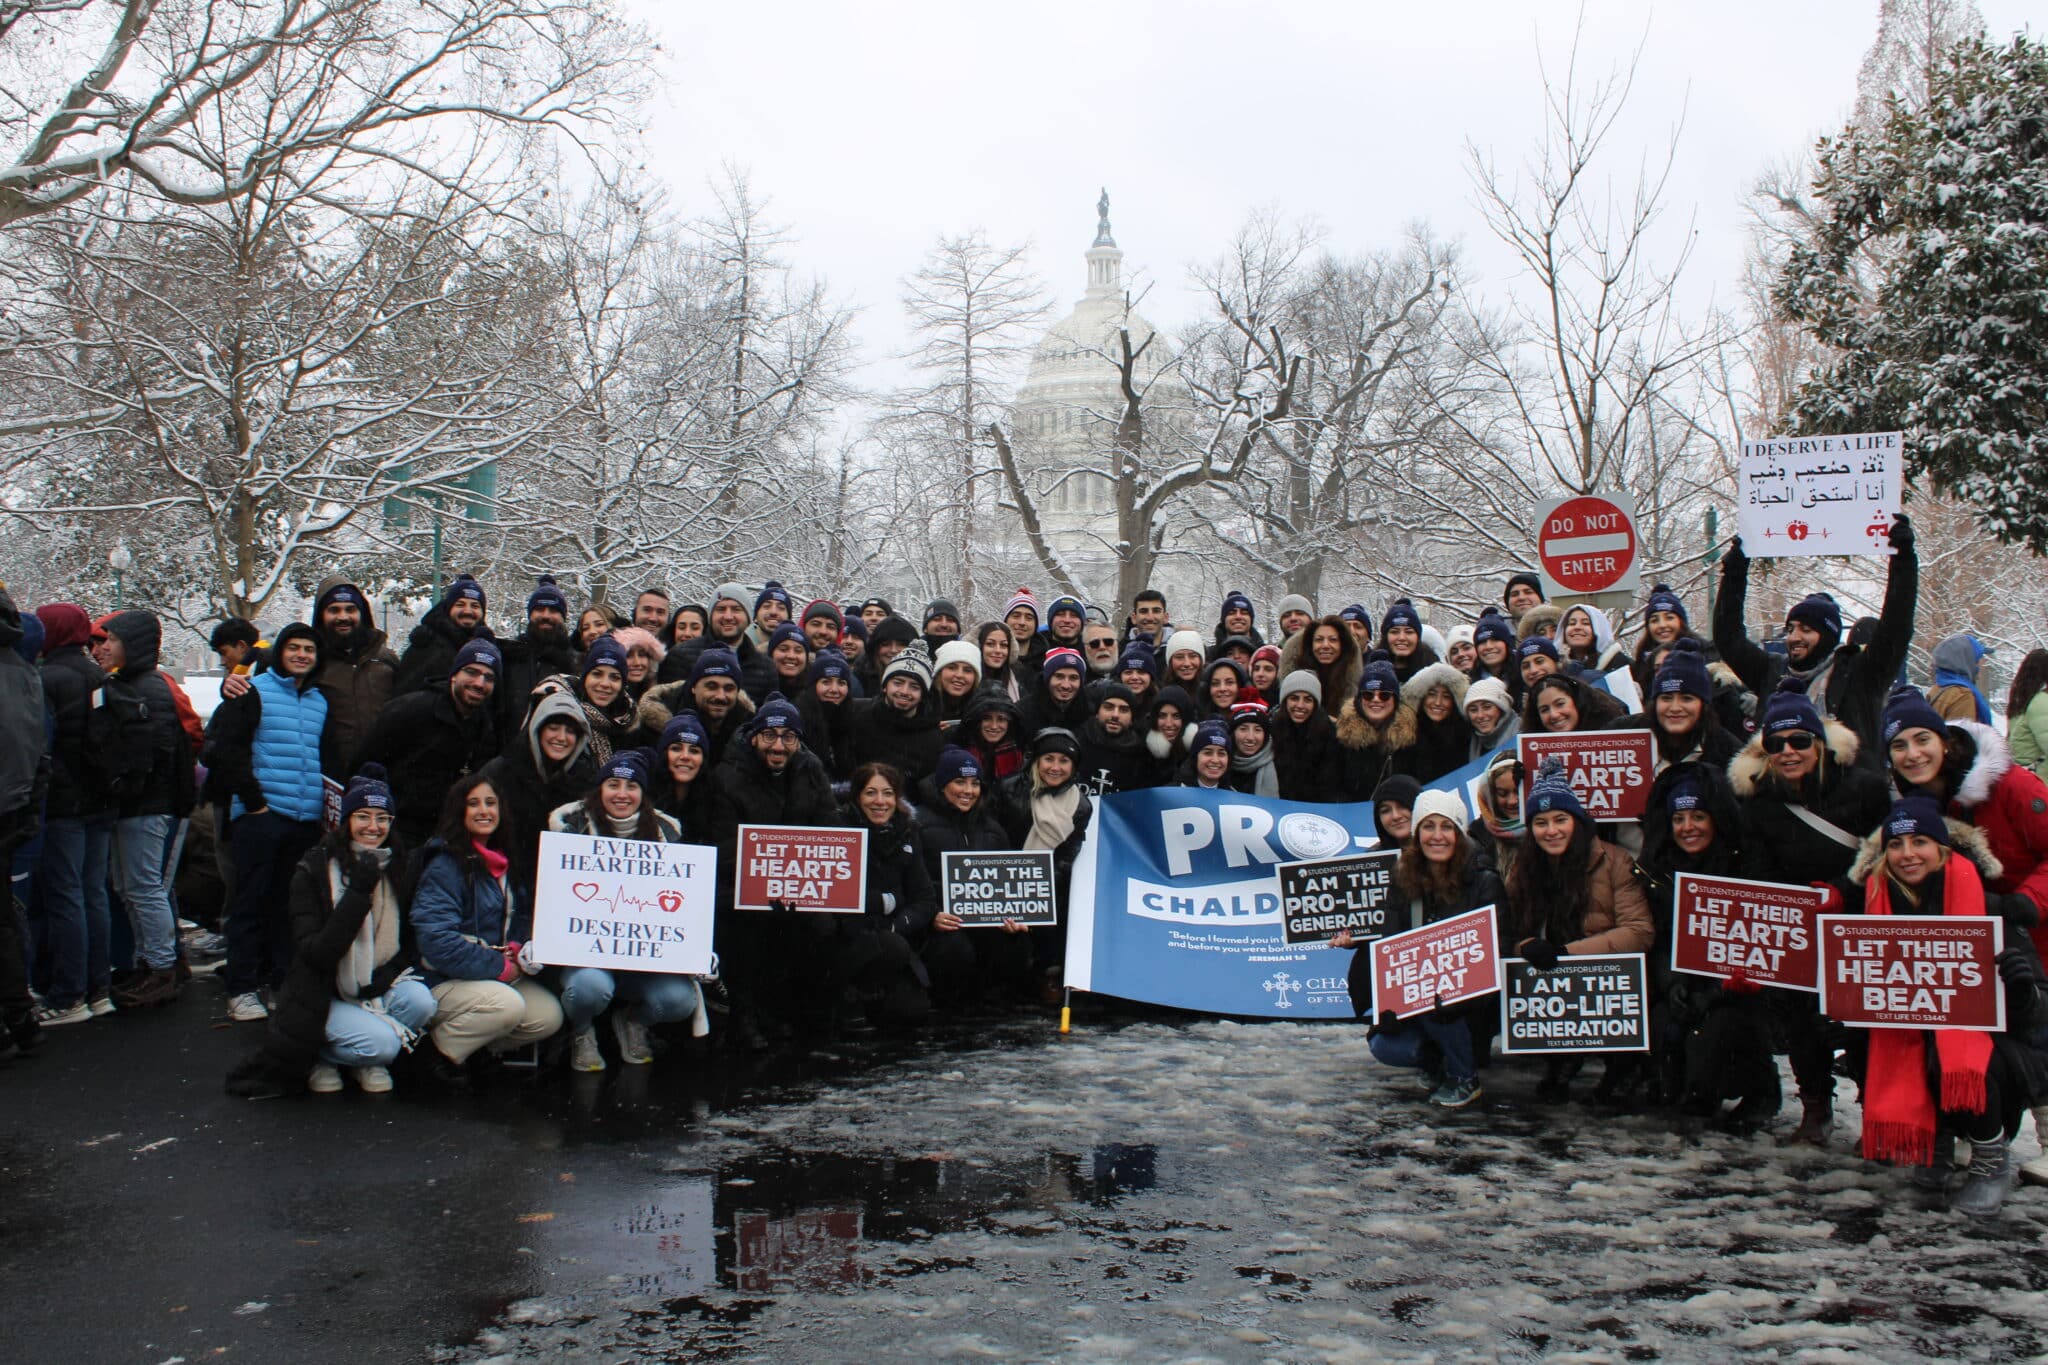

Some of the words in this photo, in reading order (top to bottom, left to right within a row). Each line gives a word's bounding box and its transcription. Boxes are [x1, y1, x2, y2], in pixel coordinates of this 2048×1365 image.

[1745, 445, 1750, 457] I
[1755, 439, 1833, 457] DESERVE
[1839, 440, 1850, 451] A
[1856, 435, 1896, 449] LIFE
[1750, 486, 1794, 509] الحياة
[1801, 480, 1858, 509] أستحق
[1866, 480, 1885, 501] أنا
[1551, 518, 1574, 534] DO
[1585, 513, 1618, 530] NOT
[1561, 557, 1616, 575] ENTER
[1578, 750, 1637, 766] THEIR
[1533, 766, 1643, 788] ARTS
[1574, 789, 1624, 809] EAT
[592, 839, 667, 860] EVERY
[756, 843, 788, 857] LET
[794, 844, 848, 859] THEIR
[560, 854, 696, 878] HEARTBEAT
[750, 859, 851, 880] HEARTS
[954, 868, 960, 880] I
[968, 868, 998, 880] AM
[1006, 866, 1043, 879] THE
[767, 879, 833, 899] BEAT
[950, 881, 1050, 899] PRO-LIFE
[1289, 880, 1295, 894] I
[1305, 876, 1338, 893] AM
[1347, 870, 1390, 888] THE
[1142, 893, 1280, 917] CHALD
[1698, 886, 1816, 906] STUDENTSFORLIFEACTION.ORG
[953, 900, 1048, 915] GENERATION
[1695, 896, 1733, 916] LET
[1740, 902, 1804, 926] THEIR
[568, 917, 685, 943] DESERVES
[1290, 910, 1385, 933] GENERATIO
[1688, 914, 1808, 950] HEARTS
[1250, 936, 1269, 945] you
[1846, 928, 1987, 937] STUDENTSFORLIFEACTION.ORG
[590, 938, 604, 953] A
[612, 939, 663, 959] LIFE
[1188, 941, 1220, 951] before
[1268, 944, 1292, 952] born
[1389, 947, 1420, 967] LET
[1426, 929, 1478, 955] THEIR
[1707, 940, 1786, 972] BEAT
[1843, 939, 1888, 957] LET
[1898, 940, 1975, 959] THEIR
[1385, 944, 1485, 989] HEARTS
[1837, 960, 1982, 987] HEARTS
[1403, 968, 1468, 1004] BEAT
[1515, 979, 1521, 994] I
[1533, 977, 1571, 993] AM
[1582, 975, 1631, 992] THE
[1509, 994, 1640, 1018] PRO-LIFE
[1863, 987, 1957, 1013] BEAT
[1512, 1019, 1637, 1038] GENERATION
